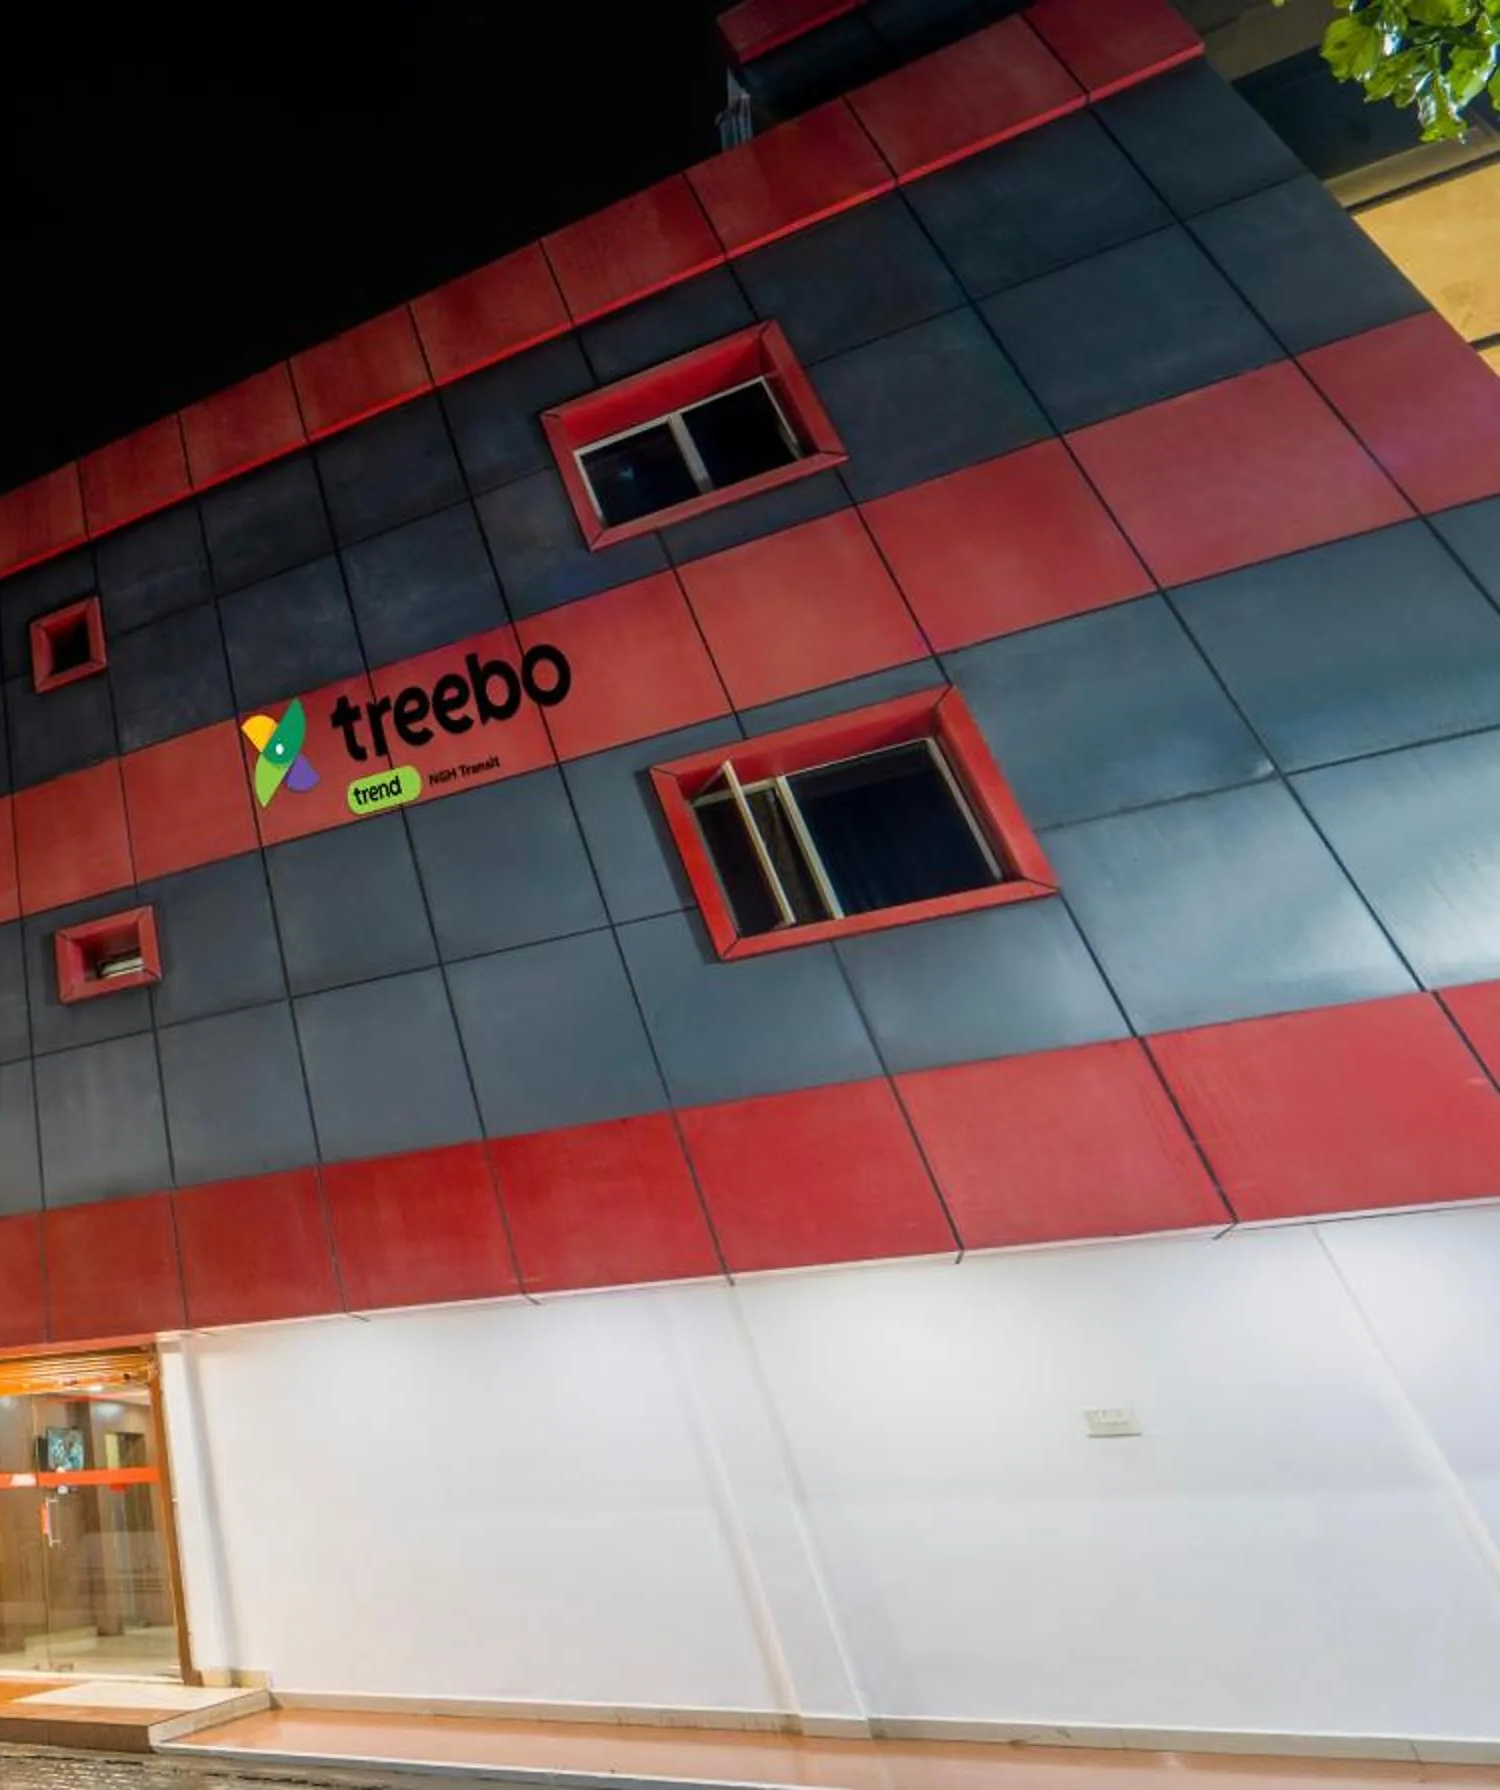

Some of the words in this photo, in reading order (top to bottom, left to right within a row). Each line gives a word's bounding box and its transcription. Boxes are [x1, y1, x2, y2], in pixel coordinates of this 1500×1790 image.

[331, 644, 571, 761] treebo
[458, 755, 501, 778] Transit
[353, 776, 402, 806] trend
